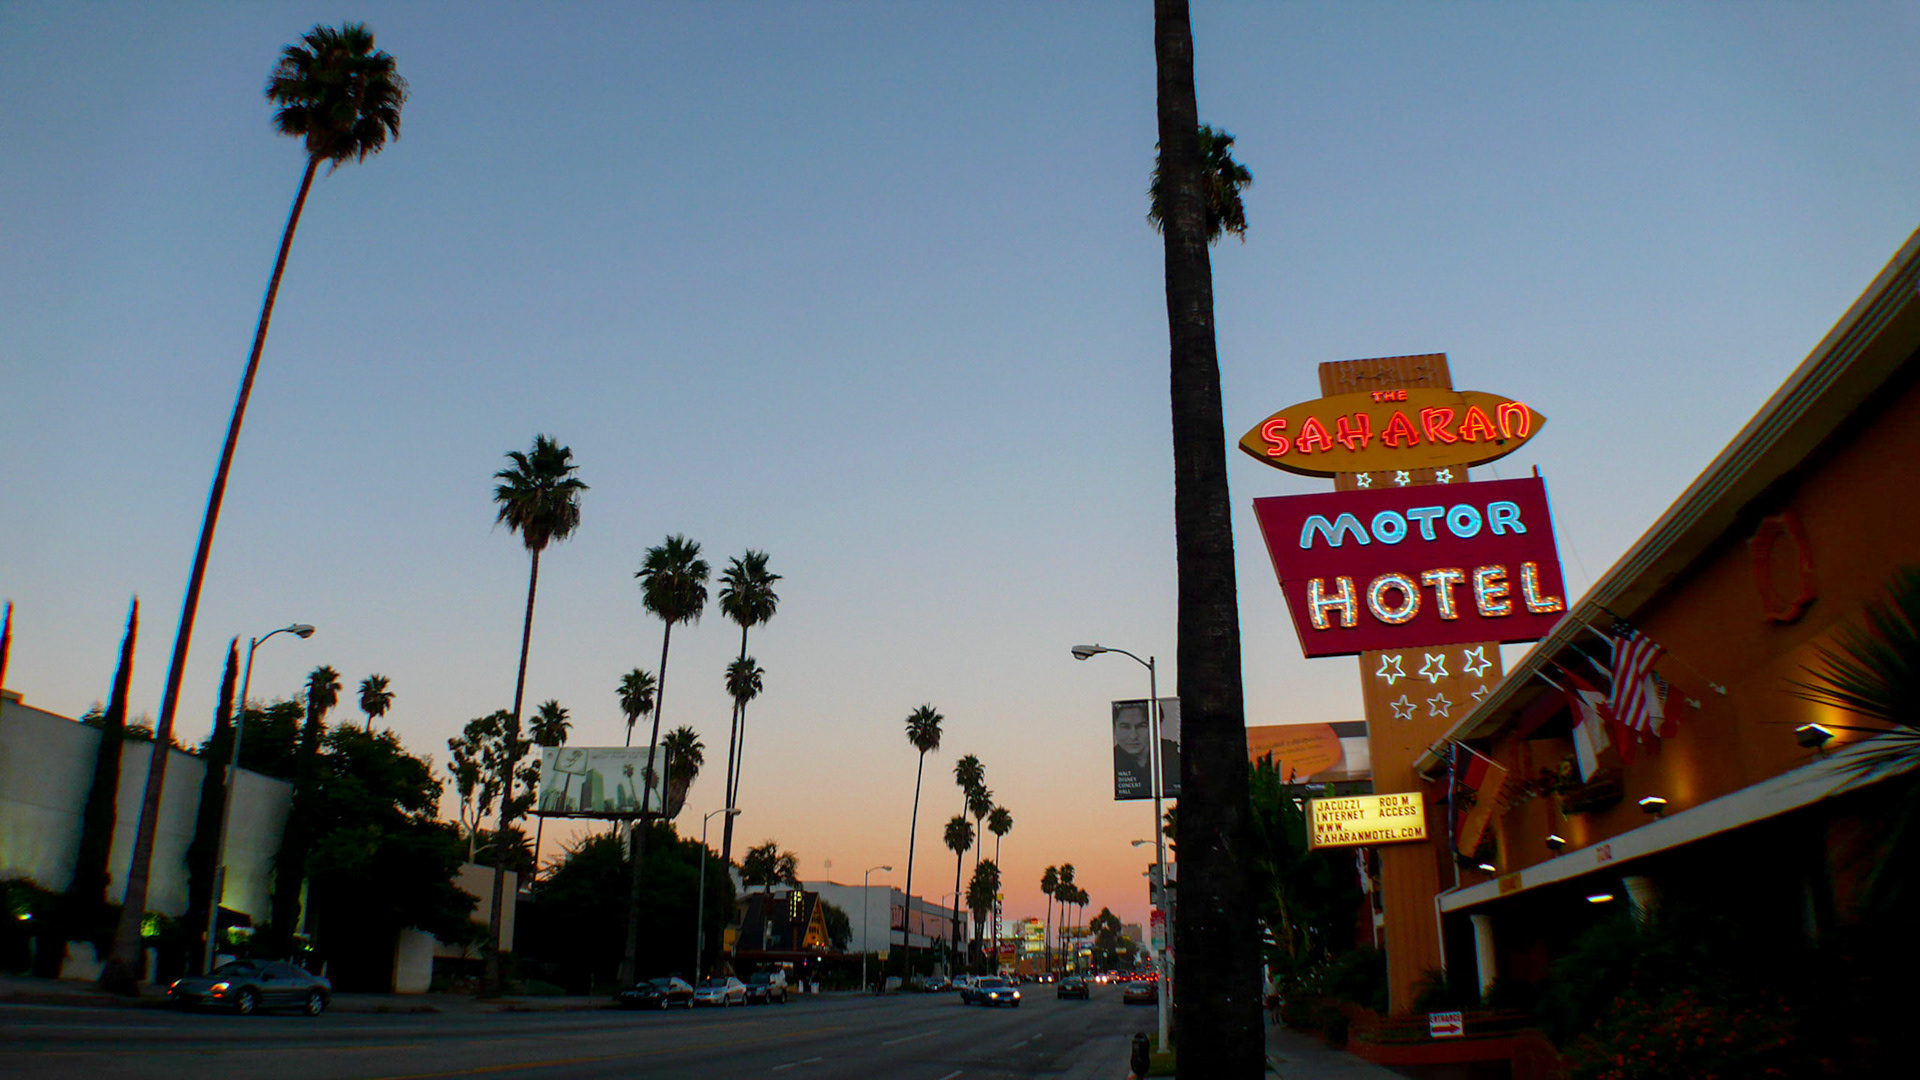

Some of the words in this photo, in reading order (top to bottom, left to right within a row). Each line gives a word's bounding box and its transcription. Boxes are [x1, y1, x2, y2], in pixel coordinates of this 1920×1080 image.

[1371, 390, 1408, 402] THE
[1261, 401, 1532, 457] SAHARAN
[1300, 501, 1527, 549] MOTOR
[1306, 561, 1564, 630] HOTEL
[1316, 810, 1365, 822] INTERNET
[1379, 806, 1417, 818] ACCESS
[1317, 799, 1361, 812] JACUZZI
[1315, 827, 1423, 845] SAHARANMOTEL.COM
